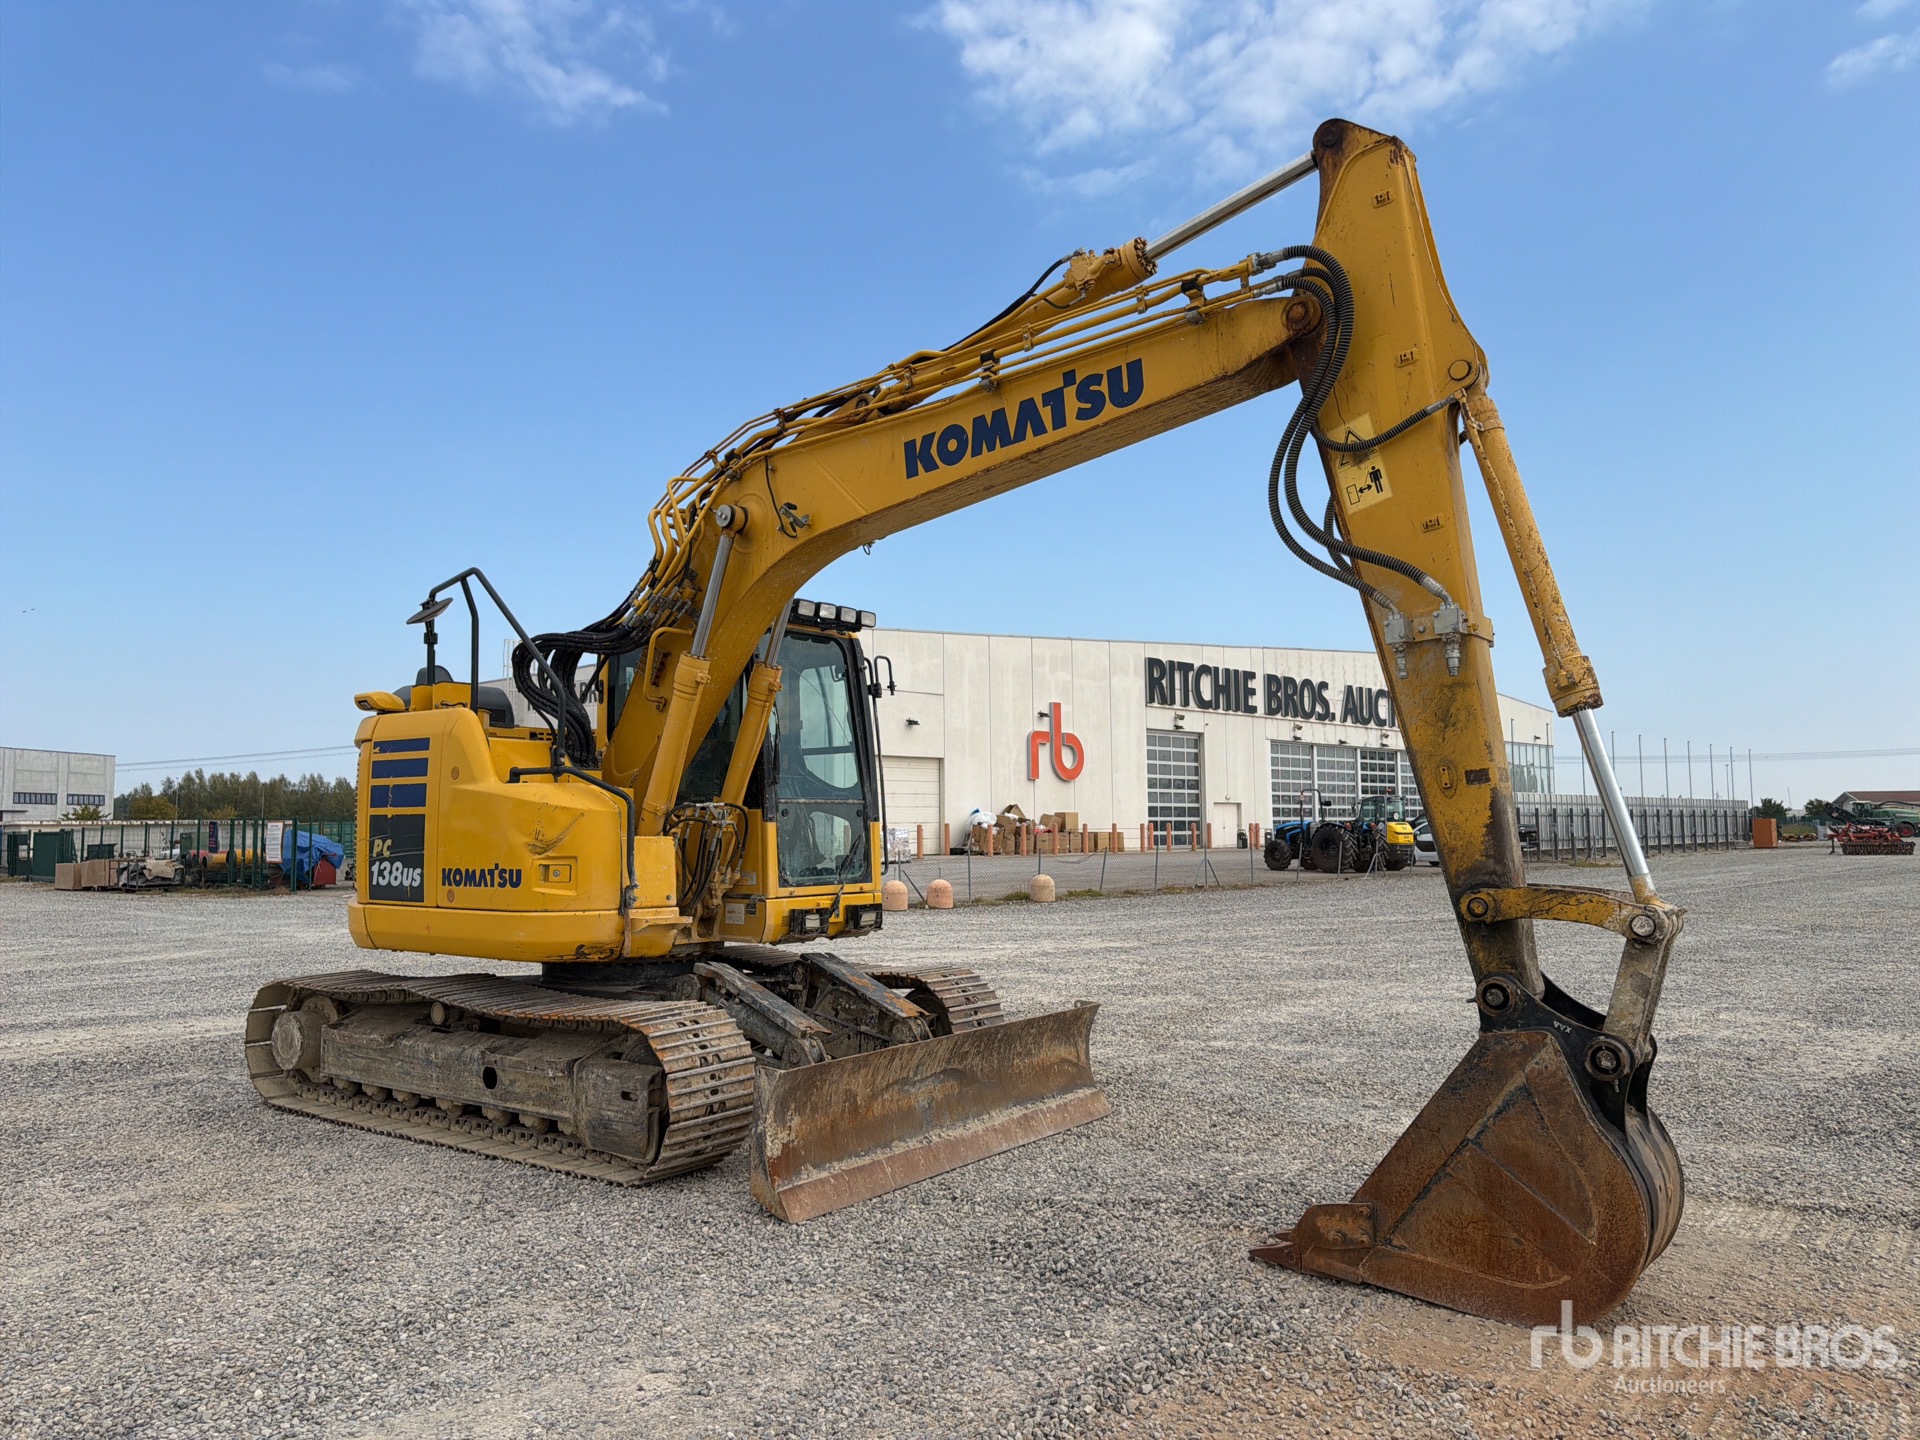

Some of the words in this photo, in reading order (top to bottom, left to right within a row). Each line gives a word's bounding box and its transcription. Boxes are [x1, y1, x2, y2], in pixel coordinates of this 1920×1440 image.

[904, 358, 1144, 479] KOMATSU
[1145, 657, 1257, 714] RITCHIE
[1264, 673, 1336, 721] BROS.
[1027, 702, 1085, 781] rb
[372, 838, 393, 858] PC
[441, 863, 522, 889] KOMATSU
